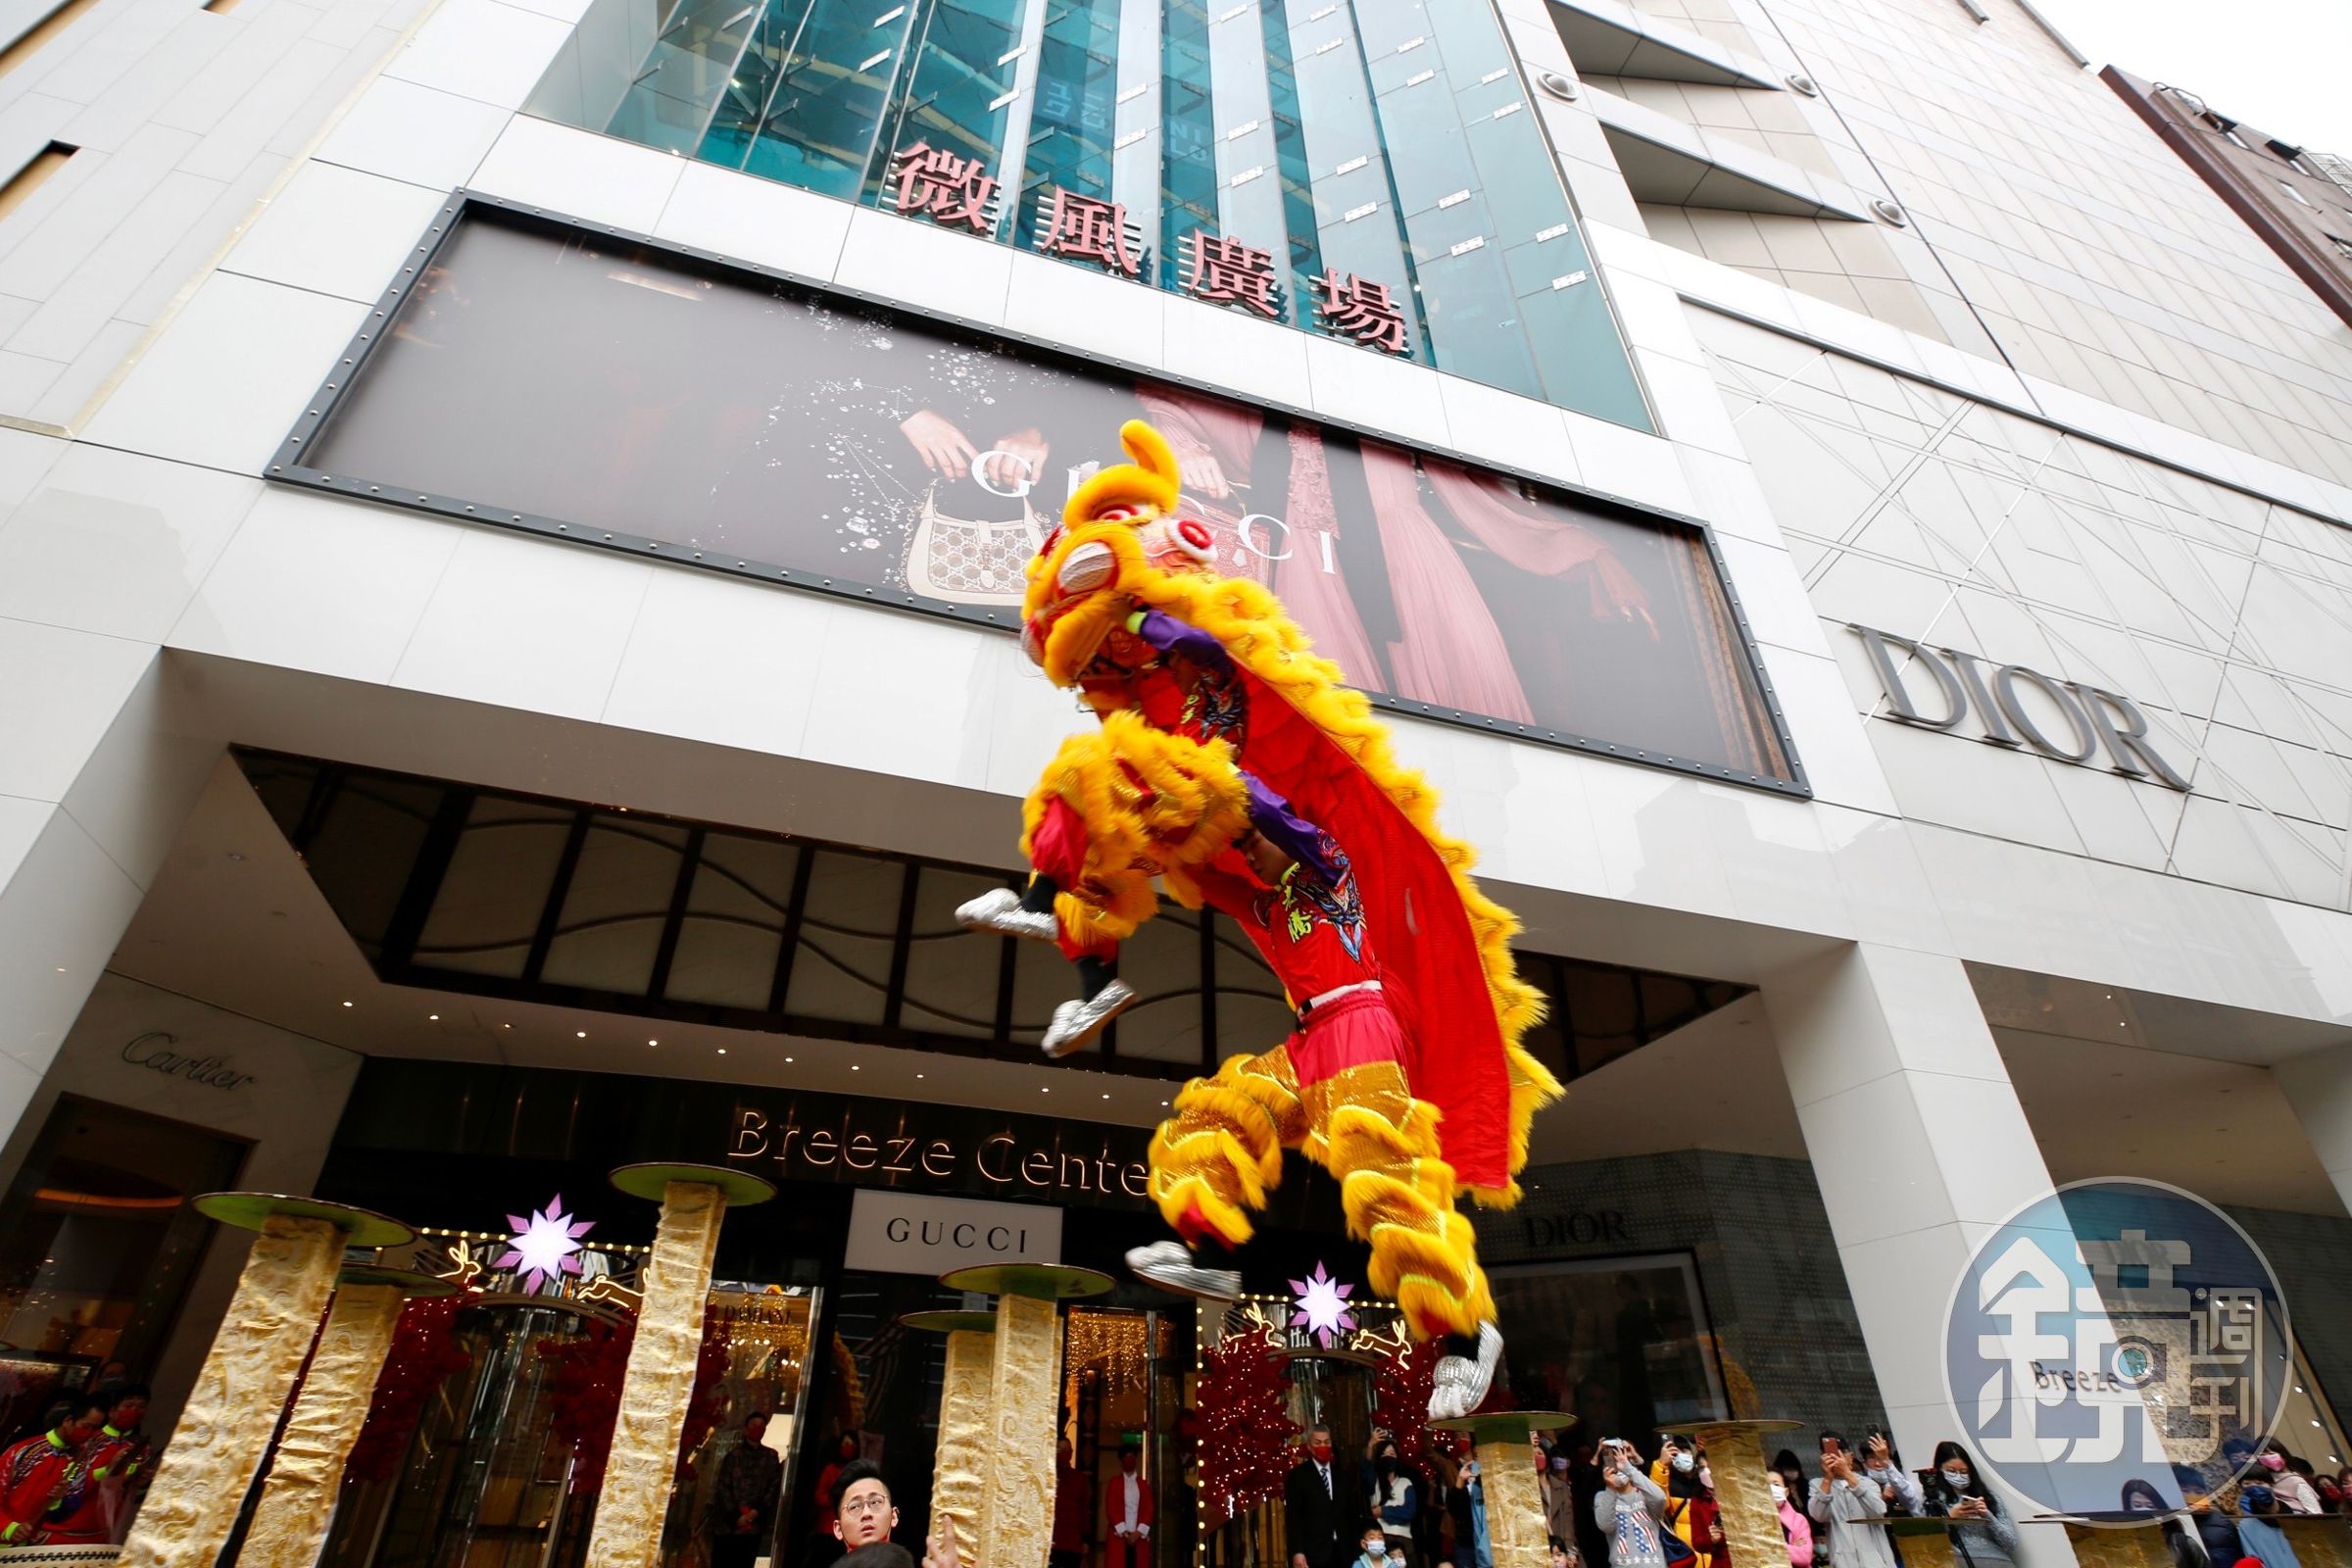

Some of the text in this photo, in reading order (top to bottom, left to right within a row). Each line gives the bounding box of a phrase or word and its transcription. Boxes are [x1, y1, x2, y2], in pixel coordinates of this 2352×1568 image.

[895, 140, 1407, 354] 微風廣場
[970, 450, 1336, 575] GCI
[1845, 622, 2195, 792] DIOR
[122, 1032, 255, 1090] Cartier
[727, 1107, 1150, 1198] Breeze Cente
[886, 1217, 1027, 1253] GUCCI
[1523, 1209, 1637, 1248] DIOR
[2028, 1360, 2123, 1394] Breeze
